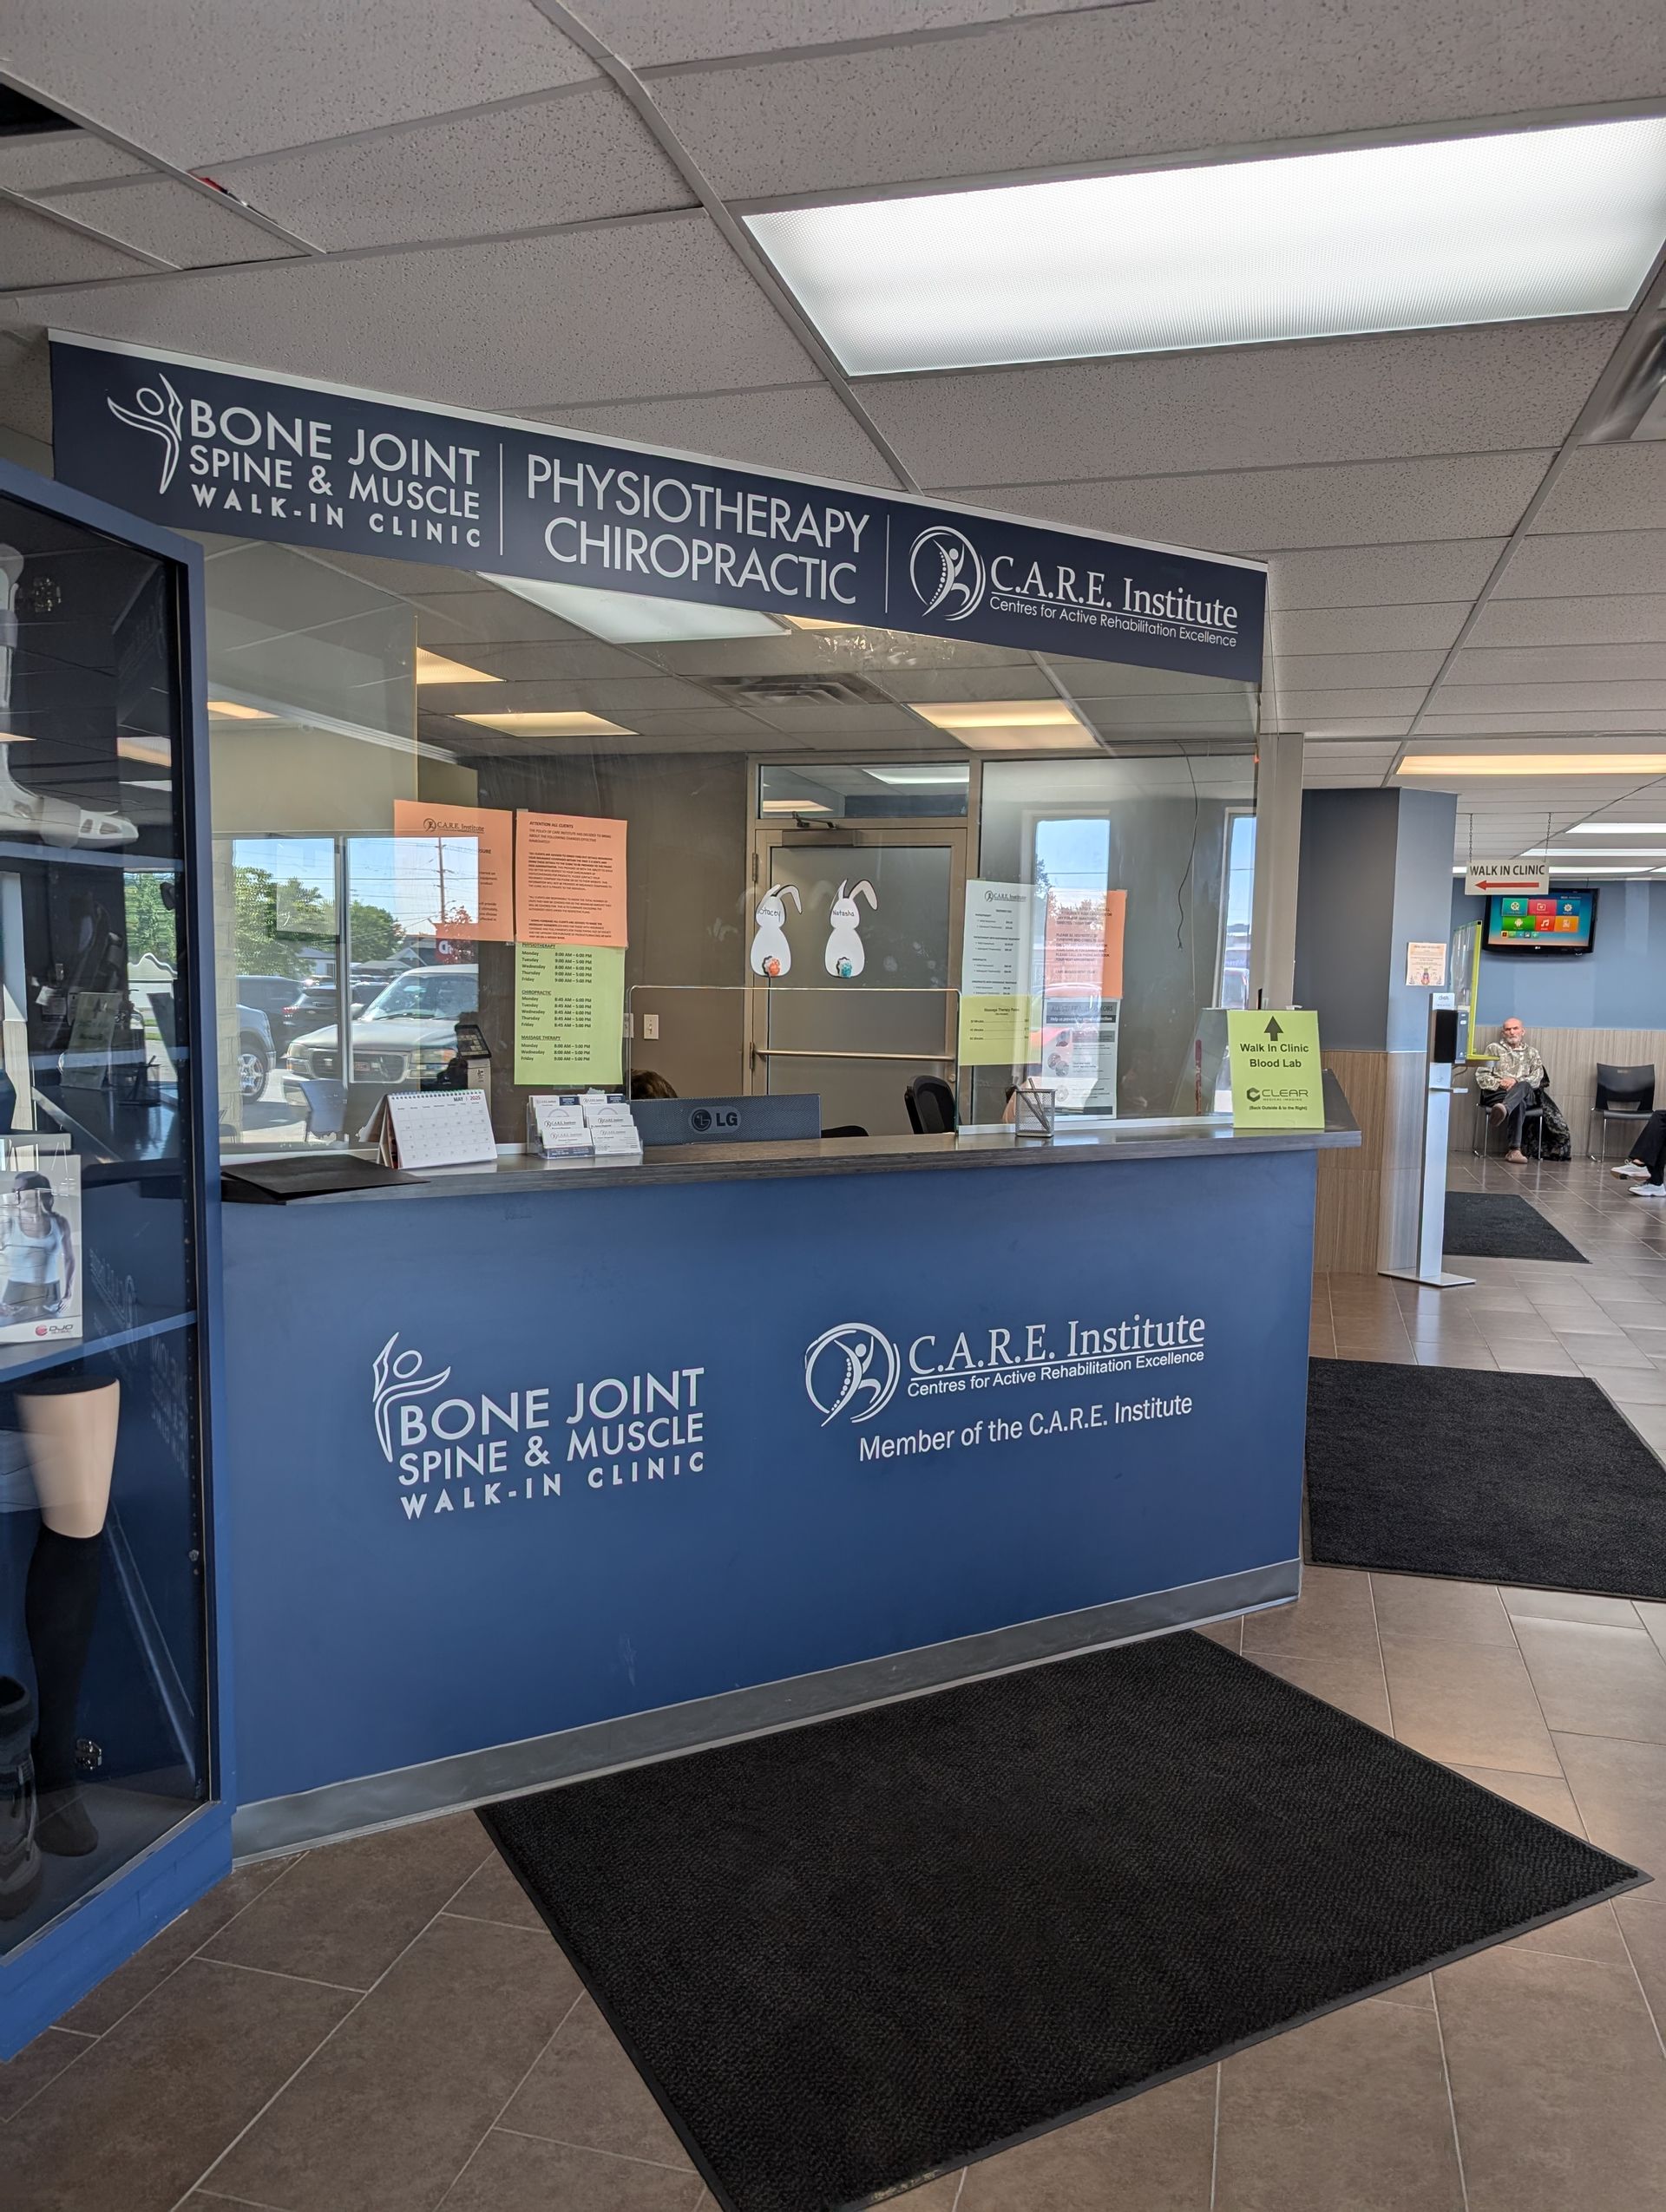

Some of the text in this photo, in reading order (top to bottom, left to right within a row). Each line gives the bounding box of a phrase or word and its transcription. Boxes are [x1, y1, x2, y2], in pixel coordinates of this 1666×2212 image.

[190, 398, 482, 486] BONE JOINT
[188, 445, 480, 520] SPINE & MUSCLE
[190, 483, 482, 548] WALK-IN CLINIC
[527, 453, 870, 553] PHYSIOTHERAPY
[543, 516, 857, 605] CHIROPRACTIC
[990, 555, 1239, 630] C.A.R.E. Institute
[989, 596, 1237, 647] Centres for Active Rehabilitation Excellence
[1470, 865, 1545, 876] WALK IN CLINIC
[1239, 1043, 1309, 1053] Walk In Clinic
[1250, 1058, 1302, 1068] Blood Lab
[717, 1112, 738, 1126] LG
[907, 1349, 1205, 1398] Centres for Active Rehabilitation Excellence
[908, 1313, 1206, 1377] C.A.R.E. Institute
[400, 1366, 705, 1447] BONE JOINT
[859, 1394, 1193, 1463] Member of the C.A.R.E. Institute
[398, 1412, 704, 1486] SPINE & MUSCLE
[400, 1451, 705, 1521] WALK-IN CLINIC
